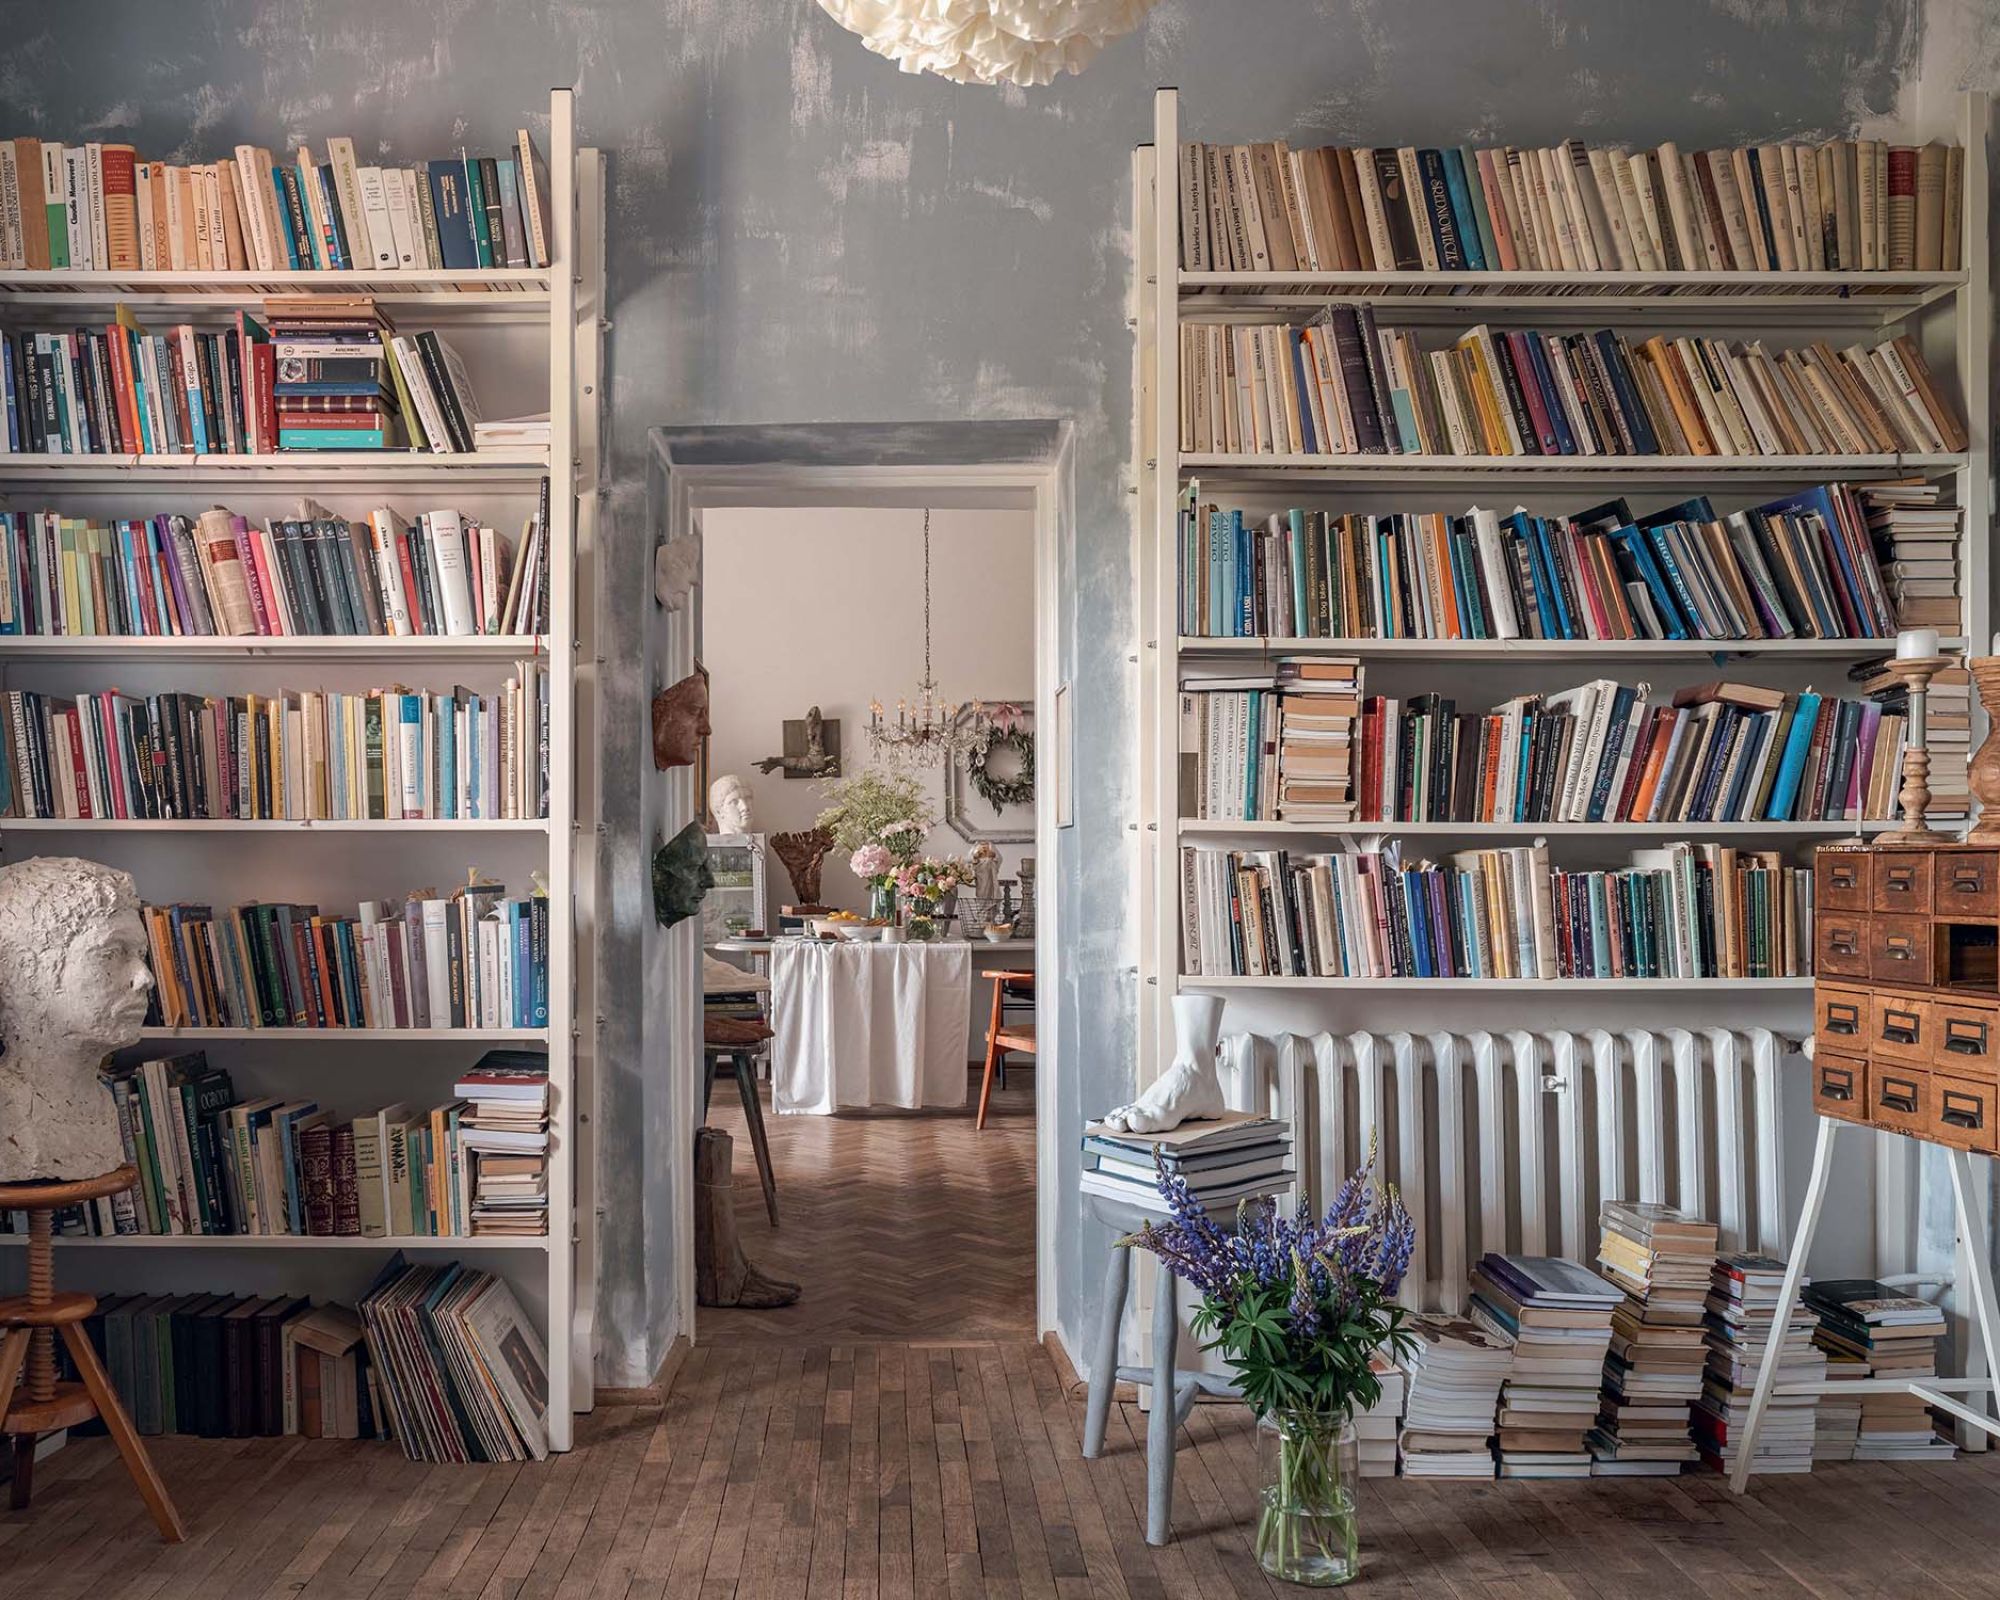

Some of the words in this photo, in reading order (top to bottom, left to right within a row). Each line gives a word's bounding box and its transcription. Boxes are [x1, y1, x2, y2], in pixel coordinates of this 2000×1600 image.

[66, 158, 75, 198] Monteverdi
[140, 167, 149, 179] 1
[153, 165, 163, 177] 2
[1208, 151, 1218, 189] Tatarkiewicz
[92, 187, 101, 222] HISTORIA
[1191, 182, 1199, 212] Estetyka
[1224, 154, 1235, 193] Tatarkiewicz
[1232, 207, 1243, 235] Estetyka
[69, 199, 78, 225] Claudio
[1193, 226, 1201, 267] Tatarkiewicz
[26, 342, 34, 355] The
[27, 355, 35, 373] Book
[1518, 411, 1531, 435] Polskie
[241, 531, 254, 565] HUMAN
[249, 569, 264, 613] ANATOMY
[1671, 571, 1697, 612] JASNEJ
[1320, 601, 1328, 618] Bóg
[1597, 682, 1610, 711] demony
[10, 691, 24, 745] HISTORIA
[1240, 699, 1248, 735] HISTORIA
[1589, 716, 1603, 747] mityczne
[217, 729, 227, 761] ŚMIERCI
[1575, 719, 1588, 754] MASTER
[1572, 754, 1581, 765] OF
[1582, 748, 1596, 775] Stwory
[218, 762, 229, 795] ODDECH
[1577, 776, 1589, 797] Mode
[1574, 797, 1585, 818] Heinz
[1599, 790, 1608, 806] Jews
[1185, 852, 1196, 904] KUCHOWICZ
[1187, 911, 1199, 950] ZBIGNIEW
